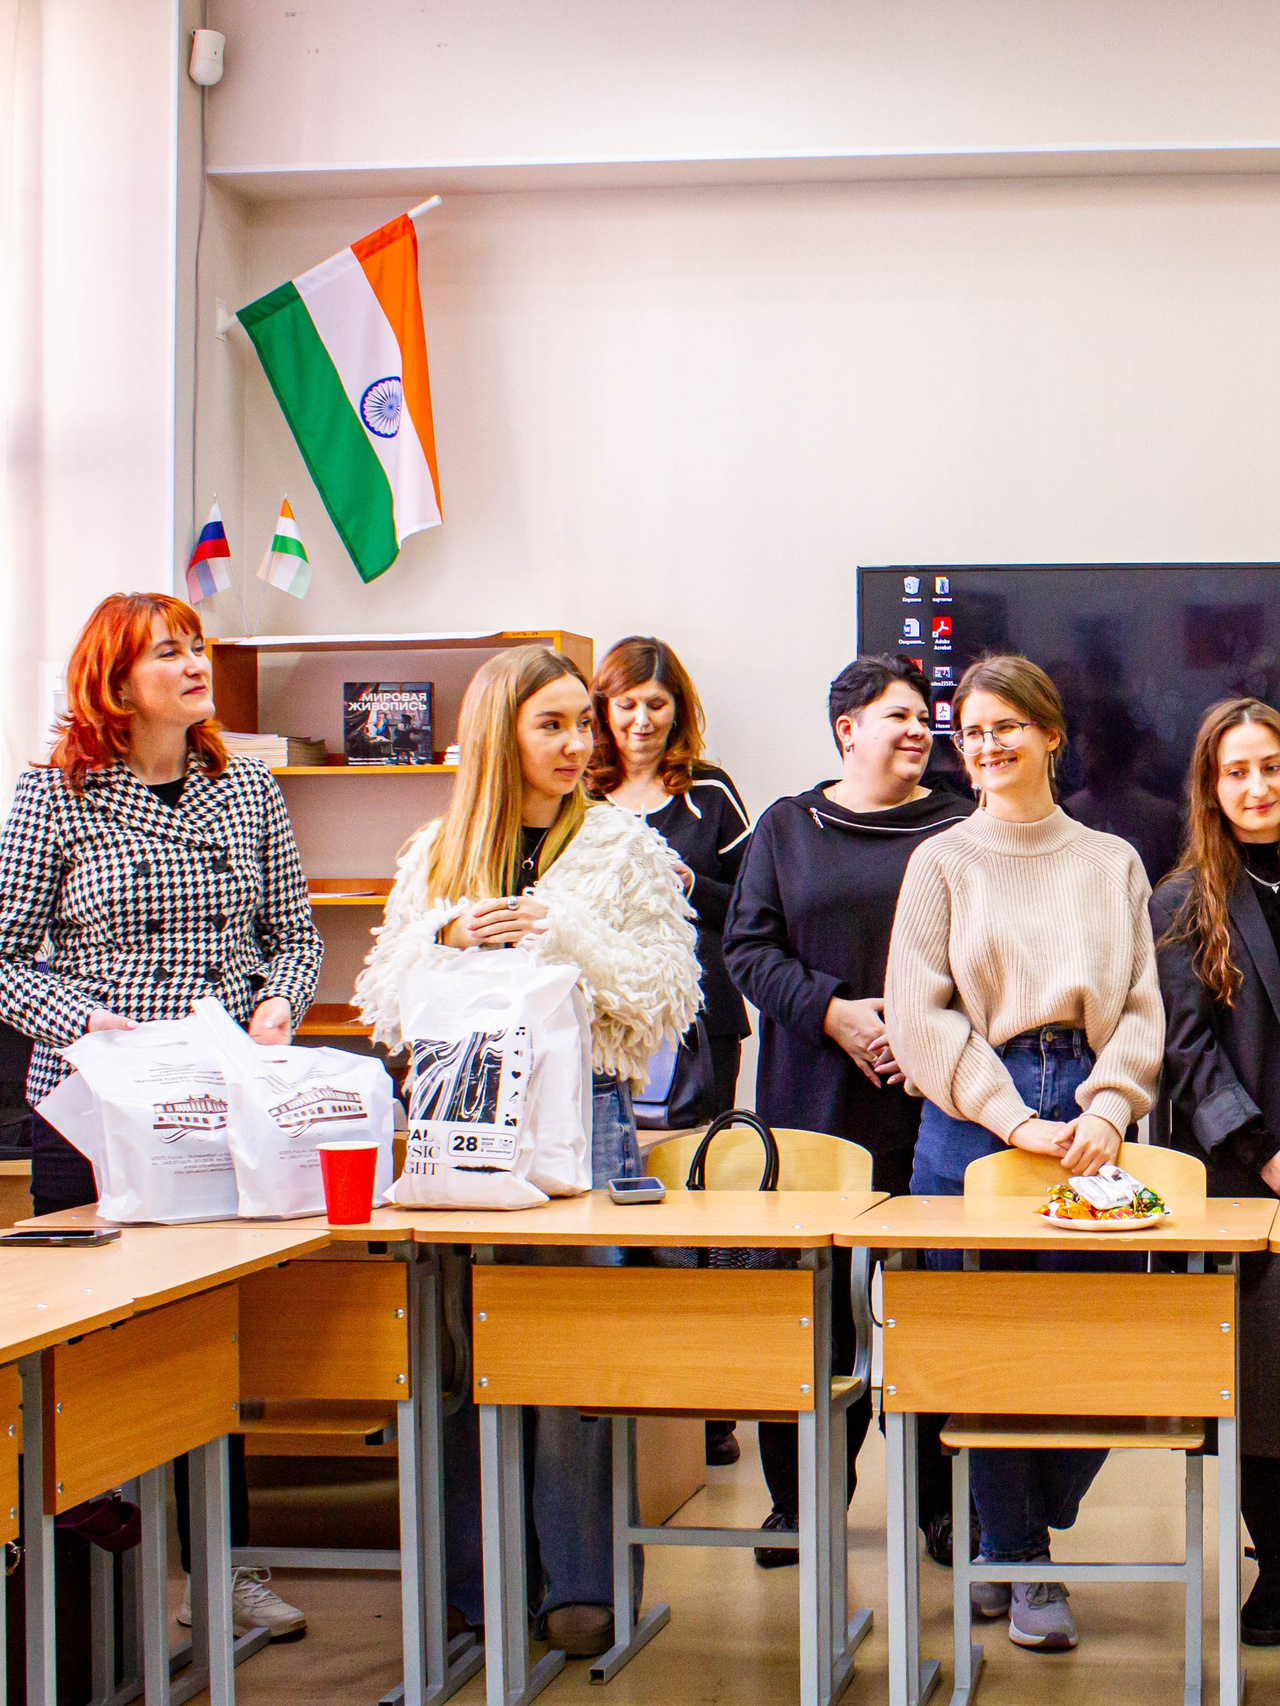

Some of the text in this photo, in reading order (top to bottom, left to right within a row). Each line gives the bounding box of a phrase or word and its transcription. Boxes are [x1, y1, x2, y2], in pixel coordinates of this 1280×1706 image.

[361, 692, 427, 702] МИРОВАЯ
[348, 702, 427, 711] ЖИВОПИСЬ
[452, 1135, 479, 1152] 28
[408, 1144, 441, 1160] SIC
